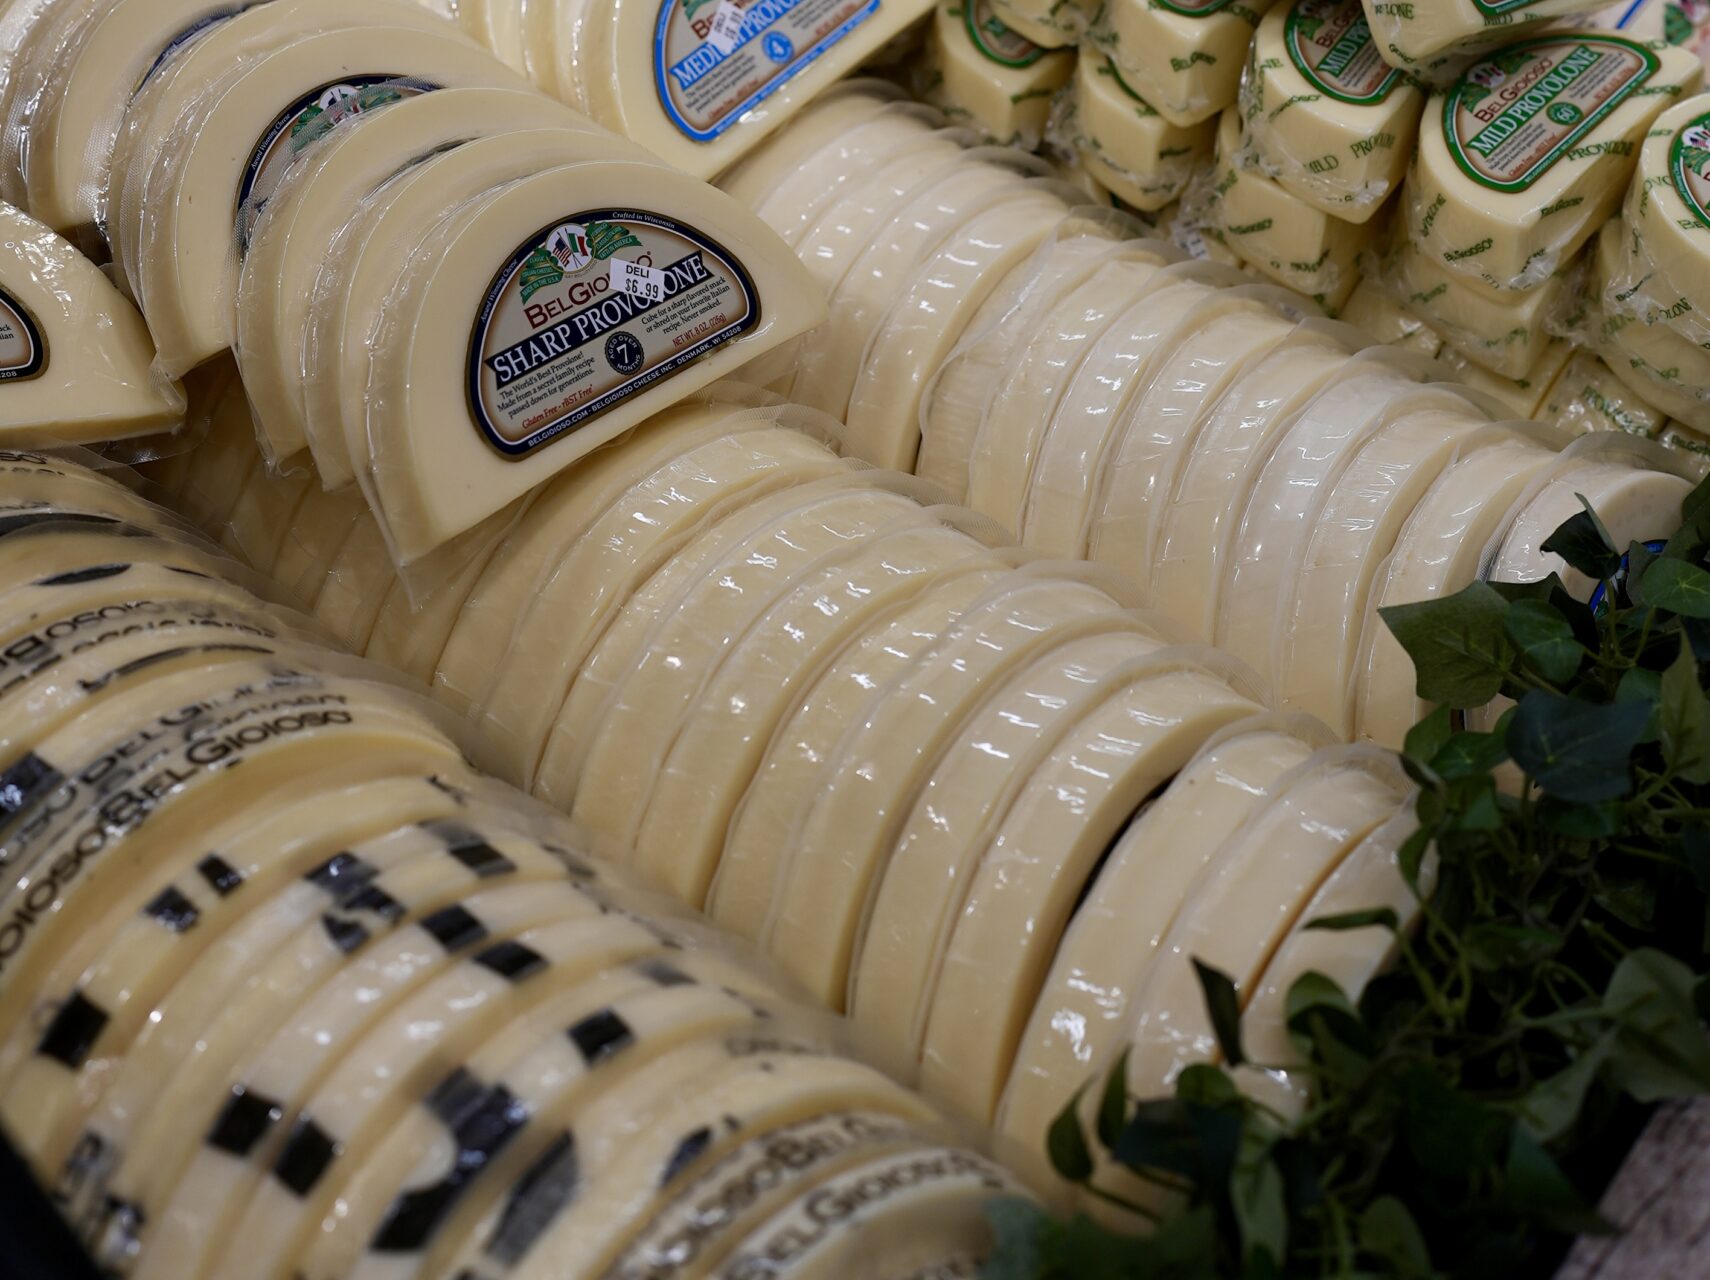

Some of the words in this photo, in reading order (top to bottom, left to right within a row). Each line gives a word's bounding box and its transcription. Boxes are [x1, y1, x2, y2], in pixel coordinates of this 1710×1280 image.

[1318, 38, 1359, 75] MILD
[1471, 114, 1517, 154] MILD
[1508, 46, 1599, 128] PROVOLONE
[1474, 58, 1553, 123] BELGIOIOSO
[1556, 106, 1575, 122] 60
[251, 150, 264, 170] Award
[261, 128, 279, 152] Winning
[274, 112, 291, 129] Cheese
[612, 211, 636, 220] Crafted
[636, 212, 643, 220] in
[644, 214, 676, 229] Wisconsin
[480, 300, 494, 324] Award
[489, 277, 507, 302] Winning
[502, 258, 519, 279] Cheese
[523, 253, 653, 330] BELGIOO
[625, 264, 650, 279] DELI
[625, 278, 659, 300] $6.99
[493, 324, 573, 383] SHARP
[572, 254, 708, 342] PROVONE
[641, 313, 658, 325] Cube
[671, 298, 687, 311] sharp
[686, 287, 710, 303] flavored
[709, 276, 726, 289] snack
[652, 316, 671, 330] shred
[677, 306, 691, 320] your
[690, 294, 712, 309] favorite
[710, 285, 730, 299] Italian
[681, 311, 701, 324] Never
[700, 300, 722, 314] smoked.
[608, 338, 619, 360] AGED
[618, 334, 638, 349] OVER
[672, 335, 686, 347] NET
[684, 329, 697, 342] WT.
[700, 321, 711, 333] OZ.
[709, 312, 727, 329] (226g)
[499, 390, 513, 400] The
[512, 376, 538, 393] World's
[536, 369, 551, 381] Best
[551, 351, 584, 373] Provolone!
[616, 342, 630, 364] 7
[616, 353, 641, 372] MONTHS
[497, 399, 517, 412] Made
[515, 391, 533, 404] from
[537, 378, 556, 393] secret
[555, 366, 578, 383] family
[576, 356, 596, 371] recipe
[508, 403, 531, 419] passed
[530, 393, 549, 407] down
[558, 368, 595, 393] generations.
[527, 410, 589, 447] BELGIOIOSO.COM
[591, 385, 634, 412] BELGIOIOSO
[633, 369, 661, 389] CHEESE
[660, 363, 676, 375] INC.
[676, 343, 713, 365] DENMARK,
[722, 324, 743, 341] 54208
[521, 413, 546, 430] Gluten
[544, 404, 559, 417] Free
[561, 392, 579, 409] rBST
